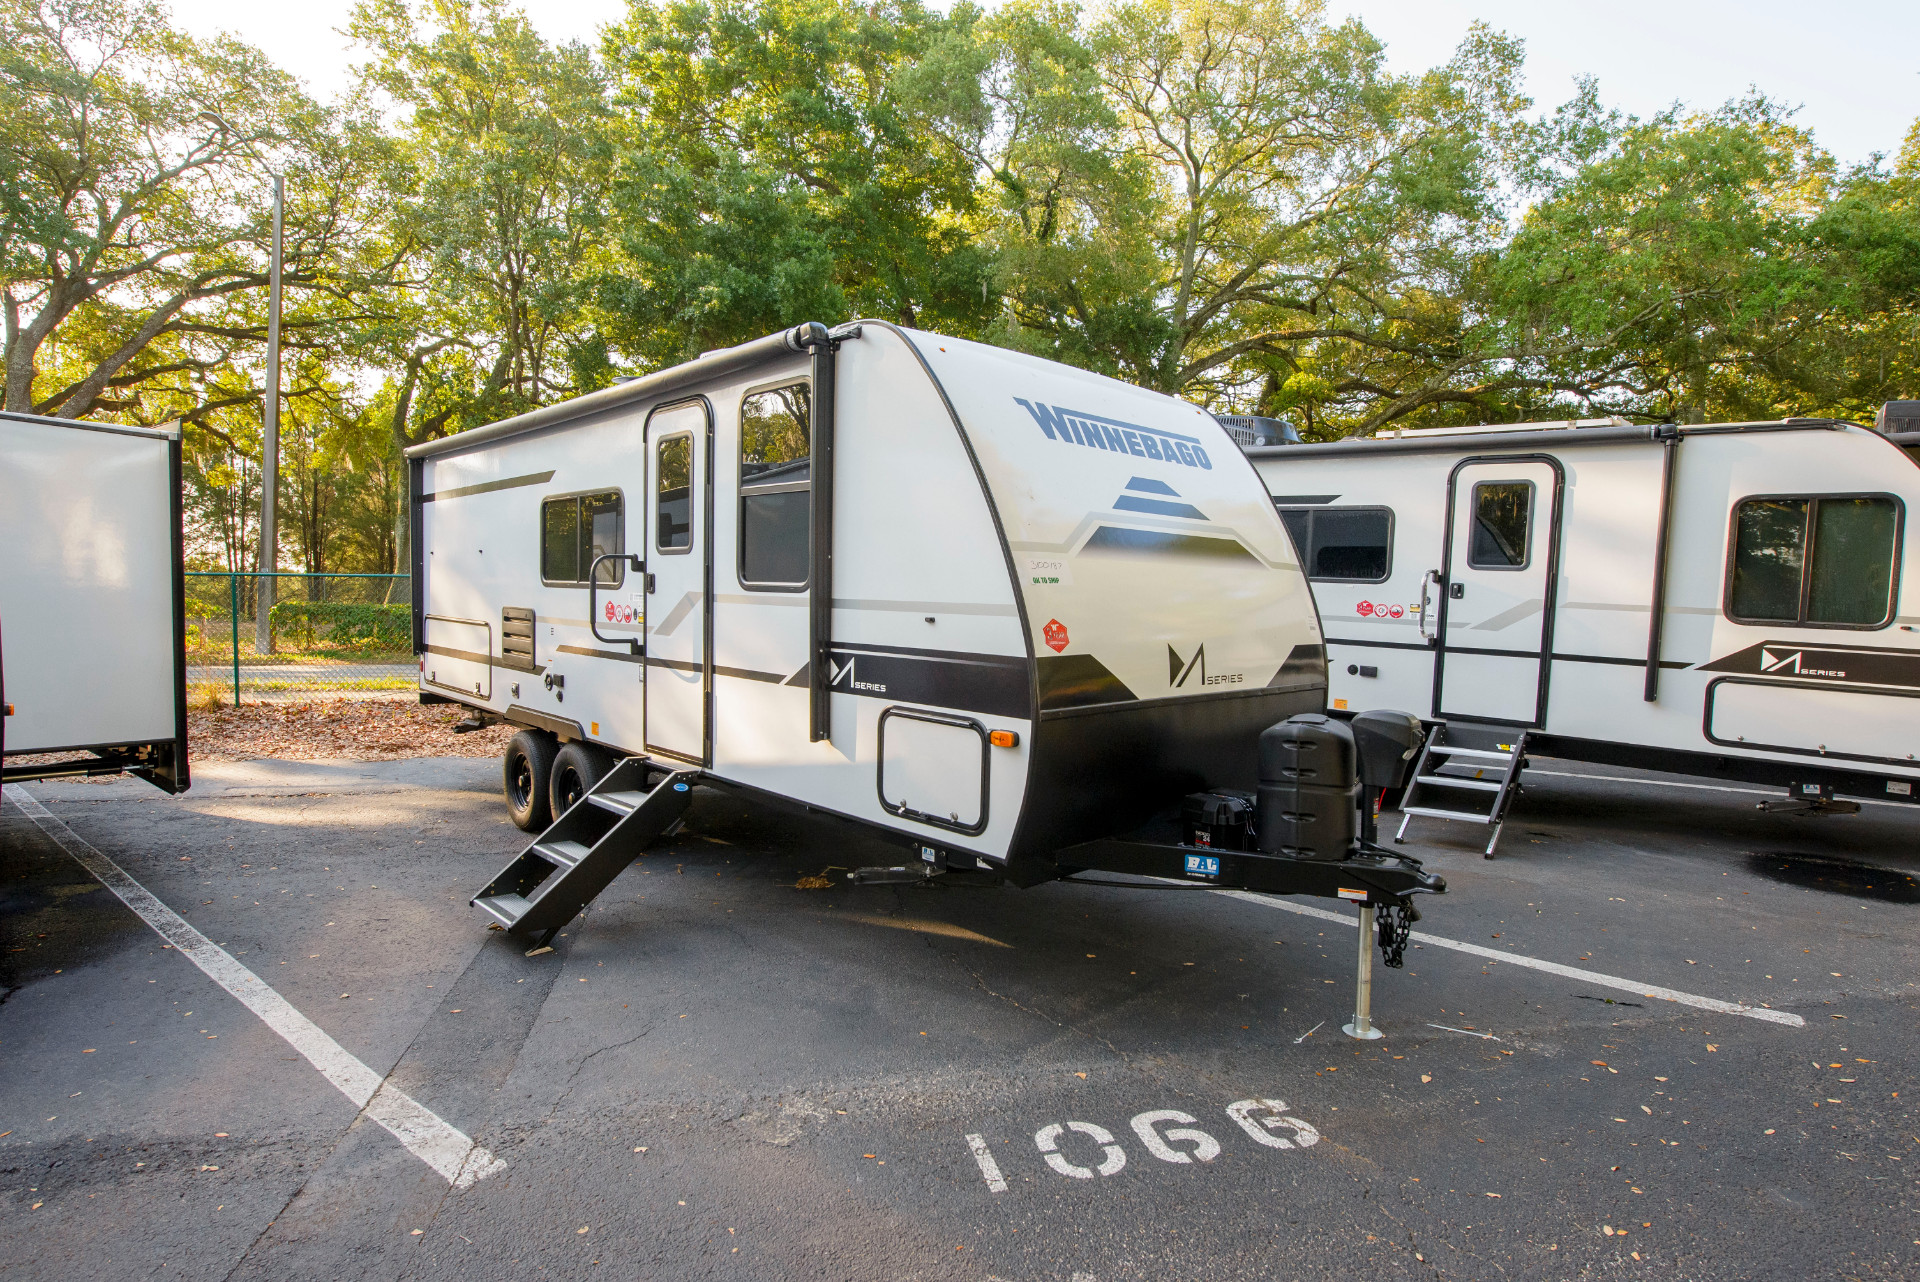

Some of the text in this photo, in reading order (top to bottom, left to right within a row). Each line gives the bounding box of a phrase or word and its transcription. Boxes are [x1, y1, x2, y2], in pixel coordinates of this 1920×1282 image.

[1013, 396, 1213, 471] WINNEBAGO
[1801, 668, 1846, 677] SERIES
[1206, 673, 1243, 685] SERIES
[854, 682, 887, 692] SERIES
[964, 1098, 1320, 1193] 1066
